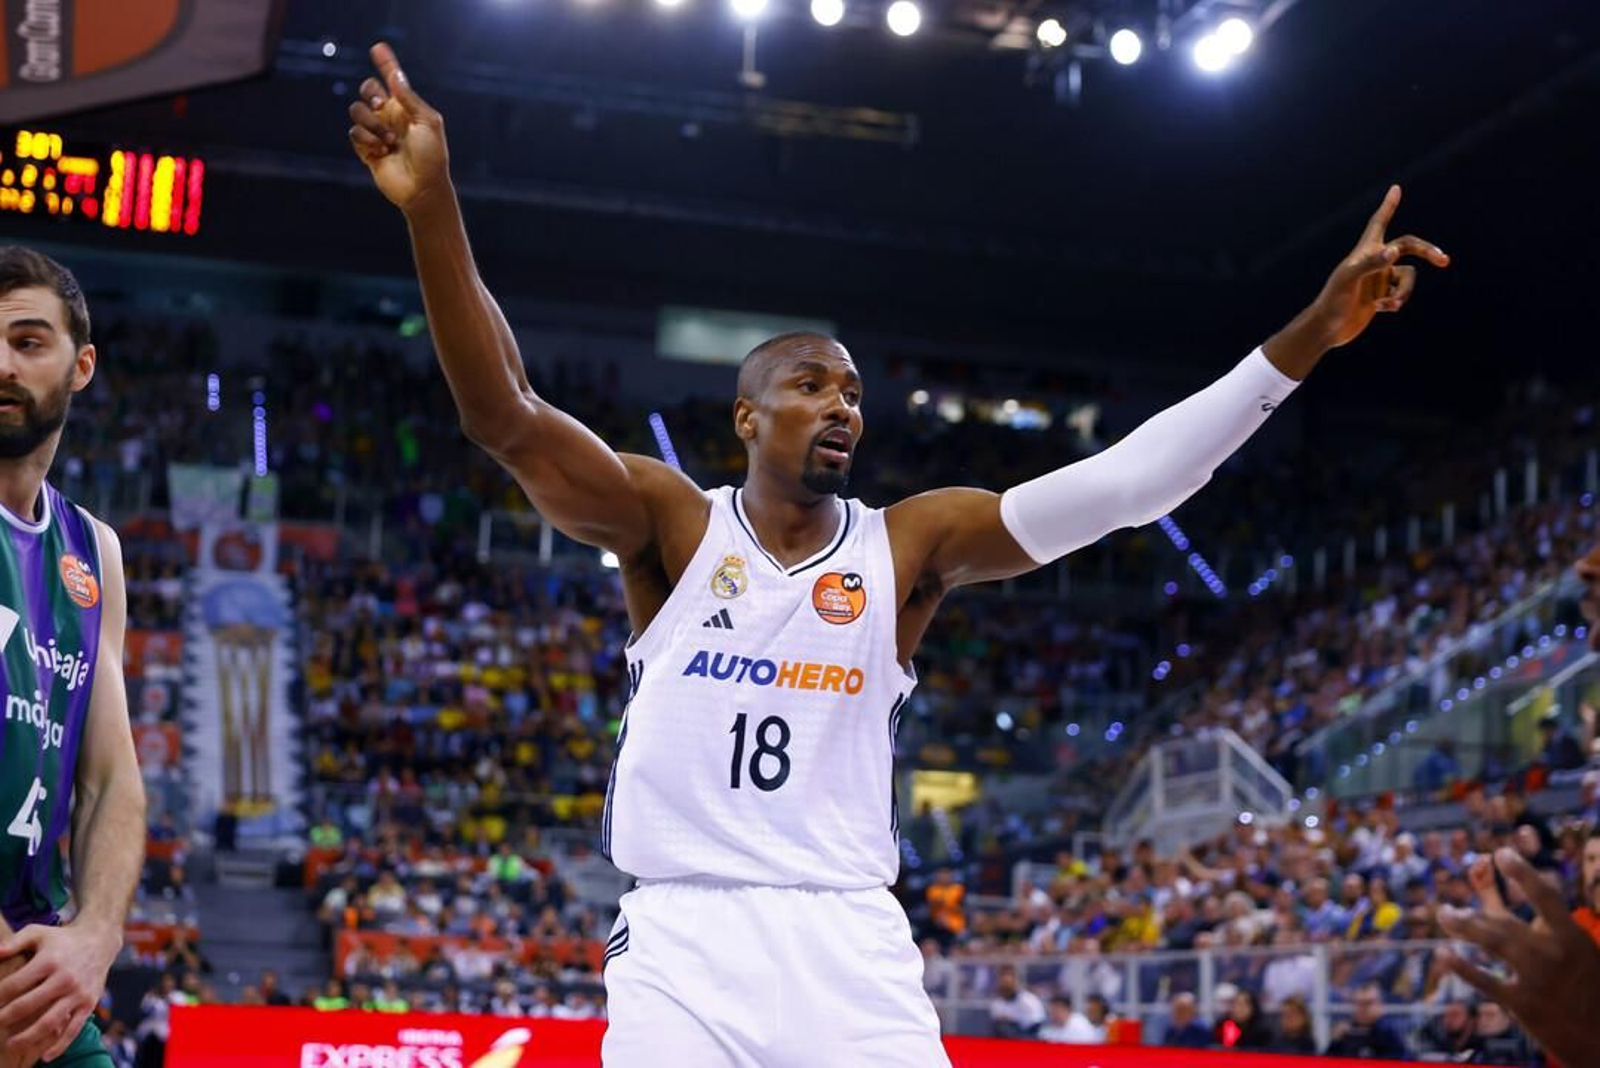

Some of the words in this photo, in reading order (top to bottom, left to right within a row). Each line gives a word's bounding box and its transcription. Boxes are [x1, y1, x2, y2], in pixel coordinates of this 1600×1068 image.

[24, 628, 90, 691] Unicaja
[682, 650, 864, 695] AUTOHERO
[729, 713, 791, 792] 18
[301, 1043, 463, 1068] EXPRESS
